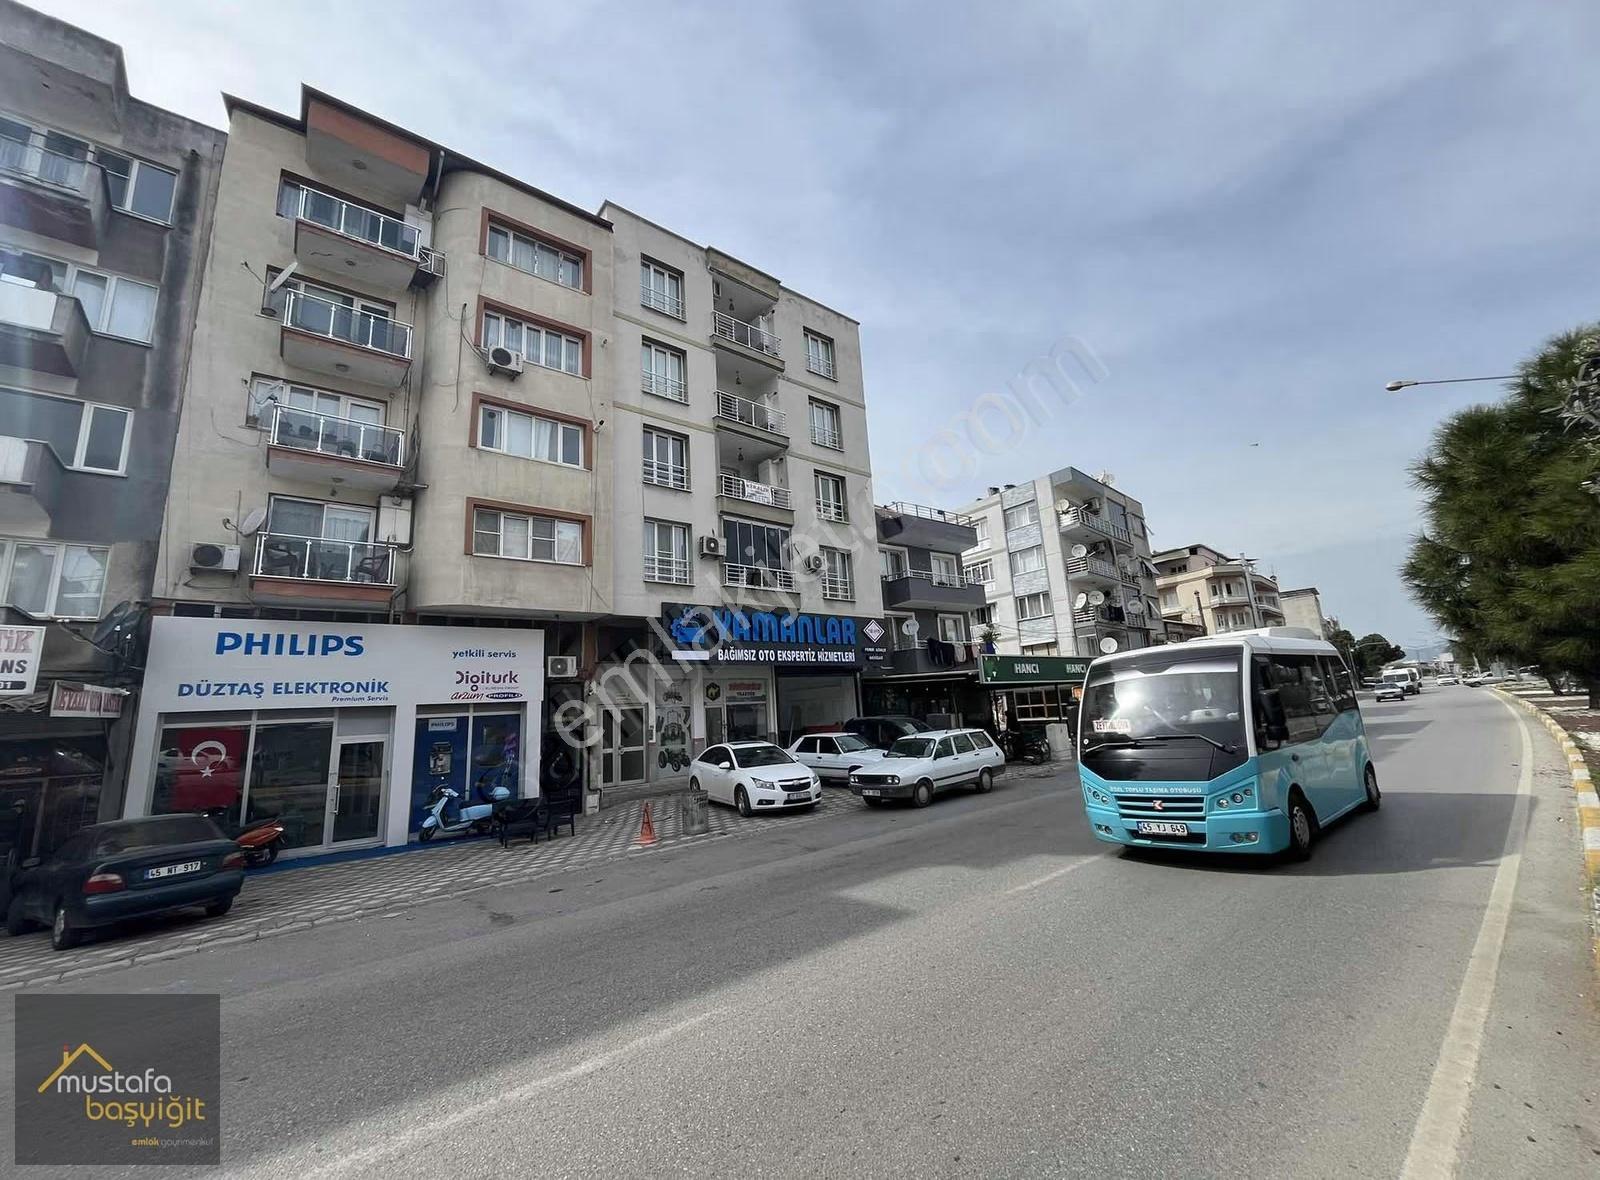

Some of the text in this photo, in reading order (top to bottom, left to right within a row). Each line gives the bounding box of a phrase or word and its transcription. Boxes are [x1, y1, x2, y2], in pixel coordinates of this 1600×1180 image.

[711, 608, 856, 645] YAMANLAR
[215, 632, 364, 657] PHILIPS
[452, 649, 517, 659] yetkili servis
[718, 646, 856, 662] BAĞIMSIZ OTO EKSPERTİZ HİZMETLERİ
[1013, 663, 1040, 674] HANCI
[1066, 664, 1087, 674] HANCI
[178, 679, 389, 698] DÜZTAŞ ELEKTRONİK
[456, 670, 519, 692] Digiturk
[1142, 822, 1185, 833] 45 YJ 649
[150, 868, 161, 877] 45
[184, 862, 199, 871] 917
